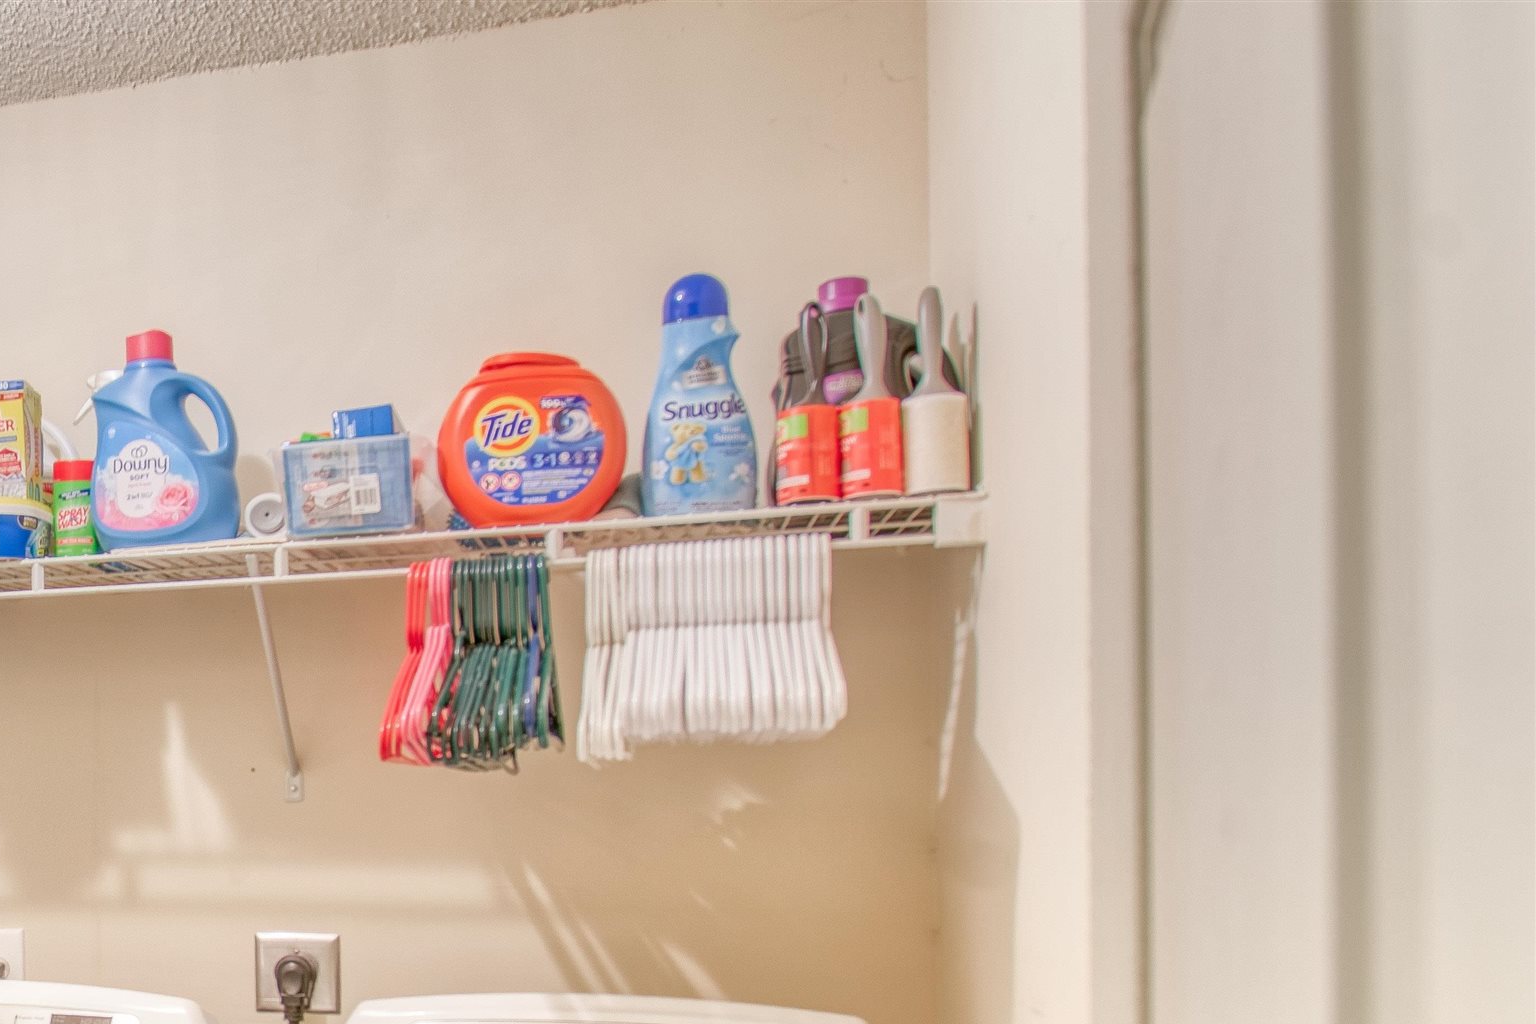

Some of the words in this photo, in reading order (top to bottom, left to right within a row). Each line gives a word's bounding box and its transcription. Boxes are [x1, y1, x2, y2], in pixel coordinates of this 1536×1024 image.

[662, 393, 746, 421] Snuggle
[482, 412, 532, 447] Tide
[113, 457, 167, 475] Downy
[58, 506, 89, 519] SPRAY
[58, 516, 87, 530] WASH
